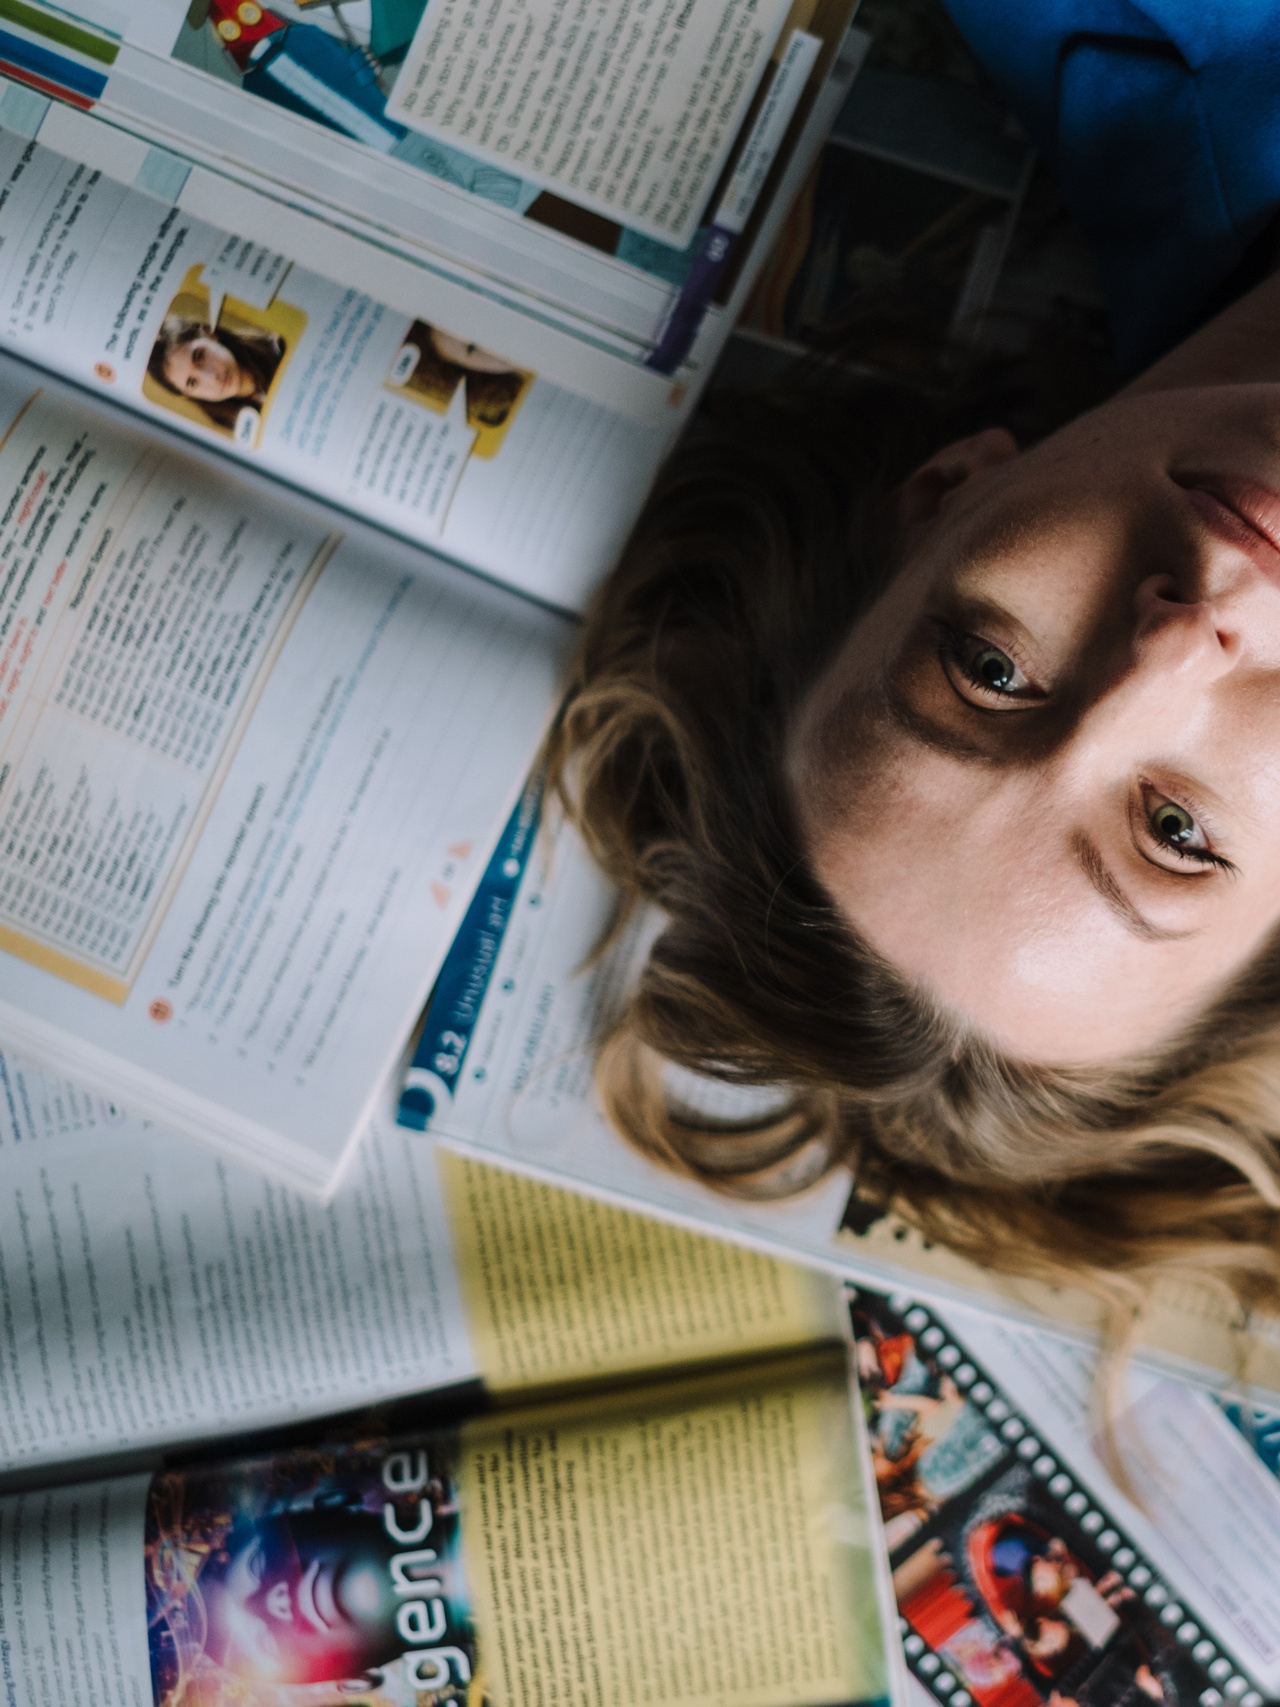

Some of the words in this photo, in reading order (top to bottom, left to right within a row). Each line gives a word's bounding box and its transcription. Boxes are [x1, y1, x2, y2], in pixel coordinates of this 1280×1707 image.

[448, 927, 502, 1025] Unusual
[427, 1026, 470, 1079] 8.2
[380, 1446, 474, 1707] gence
